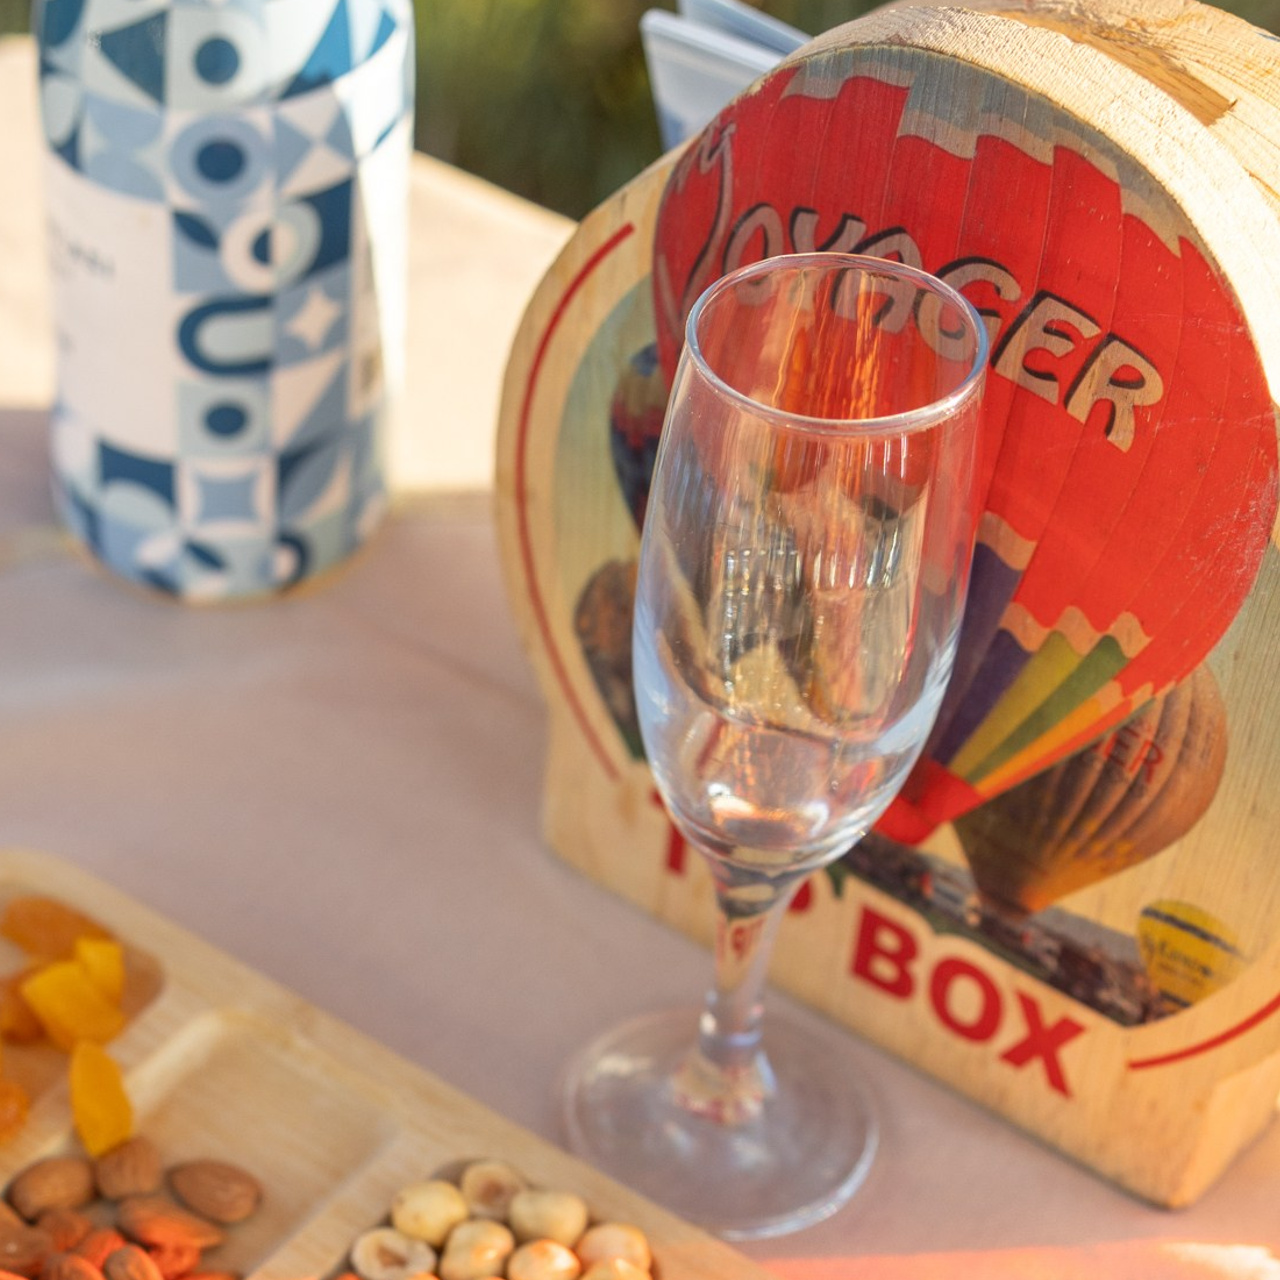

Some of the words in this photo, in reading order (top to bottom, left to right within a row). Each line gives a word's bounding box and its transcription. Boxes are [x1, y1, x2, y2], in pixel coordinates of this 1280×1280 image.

[657, 119, 1164, 453] VOYAGER
[1092, 724, 1164, 784] ER
[850, 903, 1089, 1101] BOX
